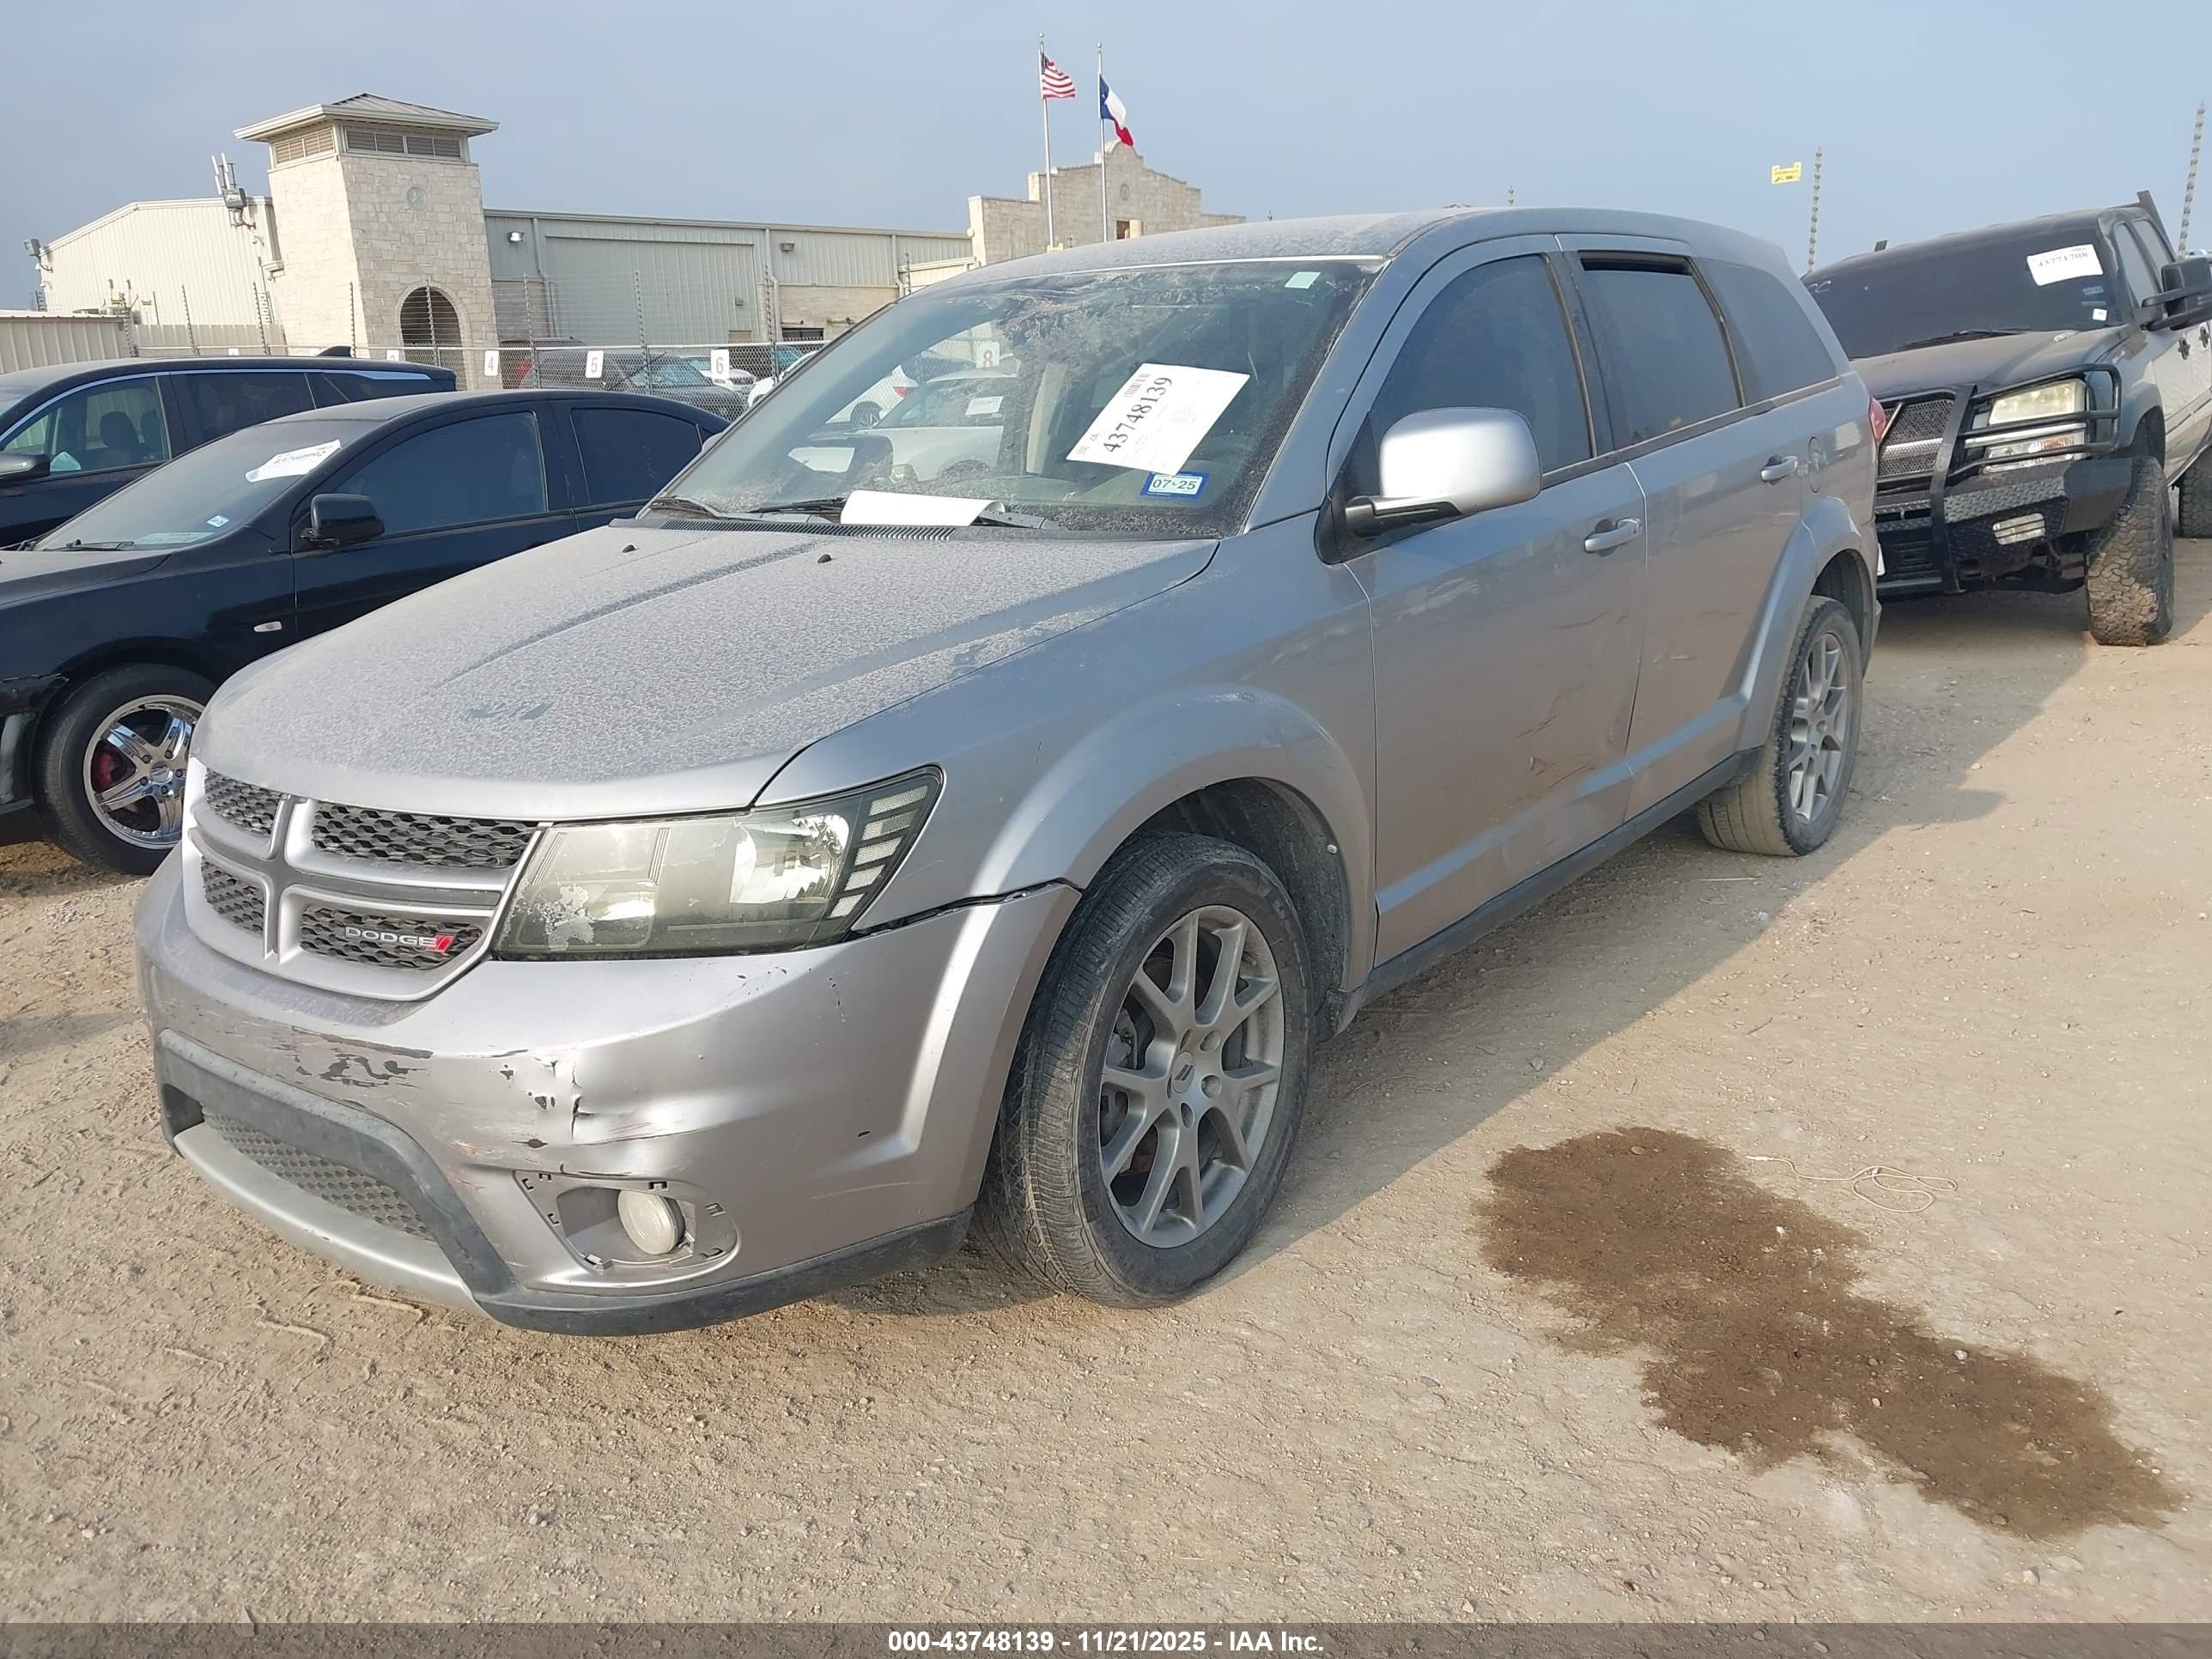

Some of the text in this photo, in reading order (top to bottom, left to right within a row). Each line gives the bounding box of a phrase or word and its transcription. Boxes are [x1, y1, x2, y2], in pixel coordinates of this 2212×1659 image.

[488, 356, 494, 372] 4
[591, 356, 599, 373] 5
[715, 356, 724, 374] 6
[1103, 377, 1172, 453] 43748139
[345, 927, 438, 947] DODGE
